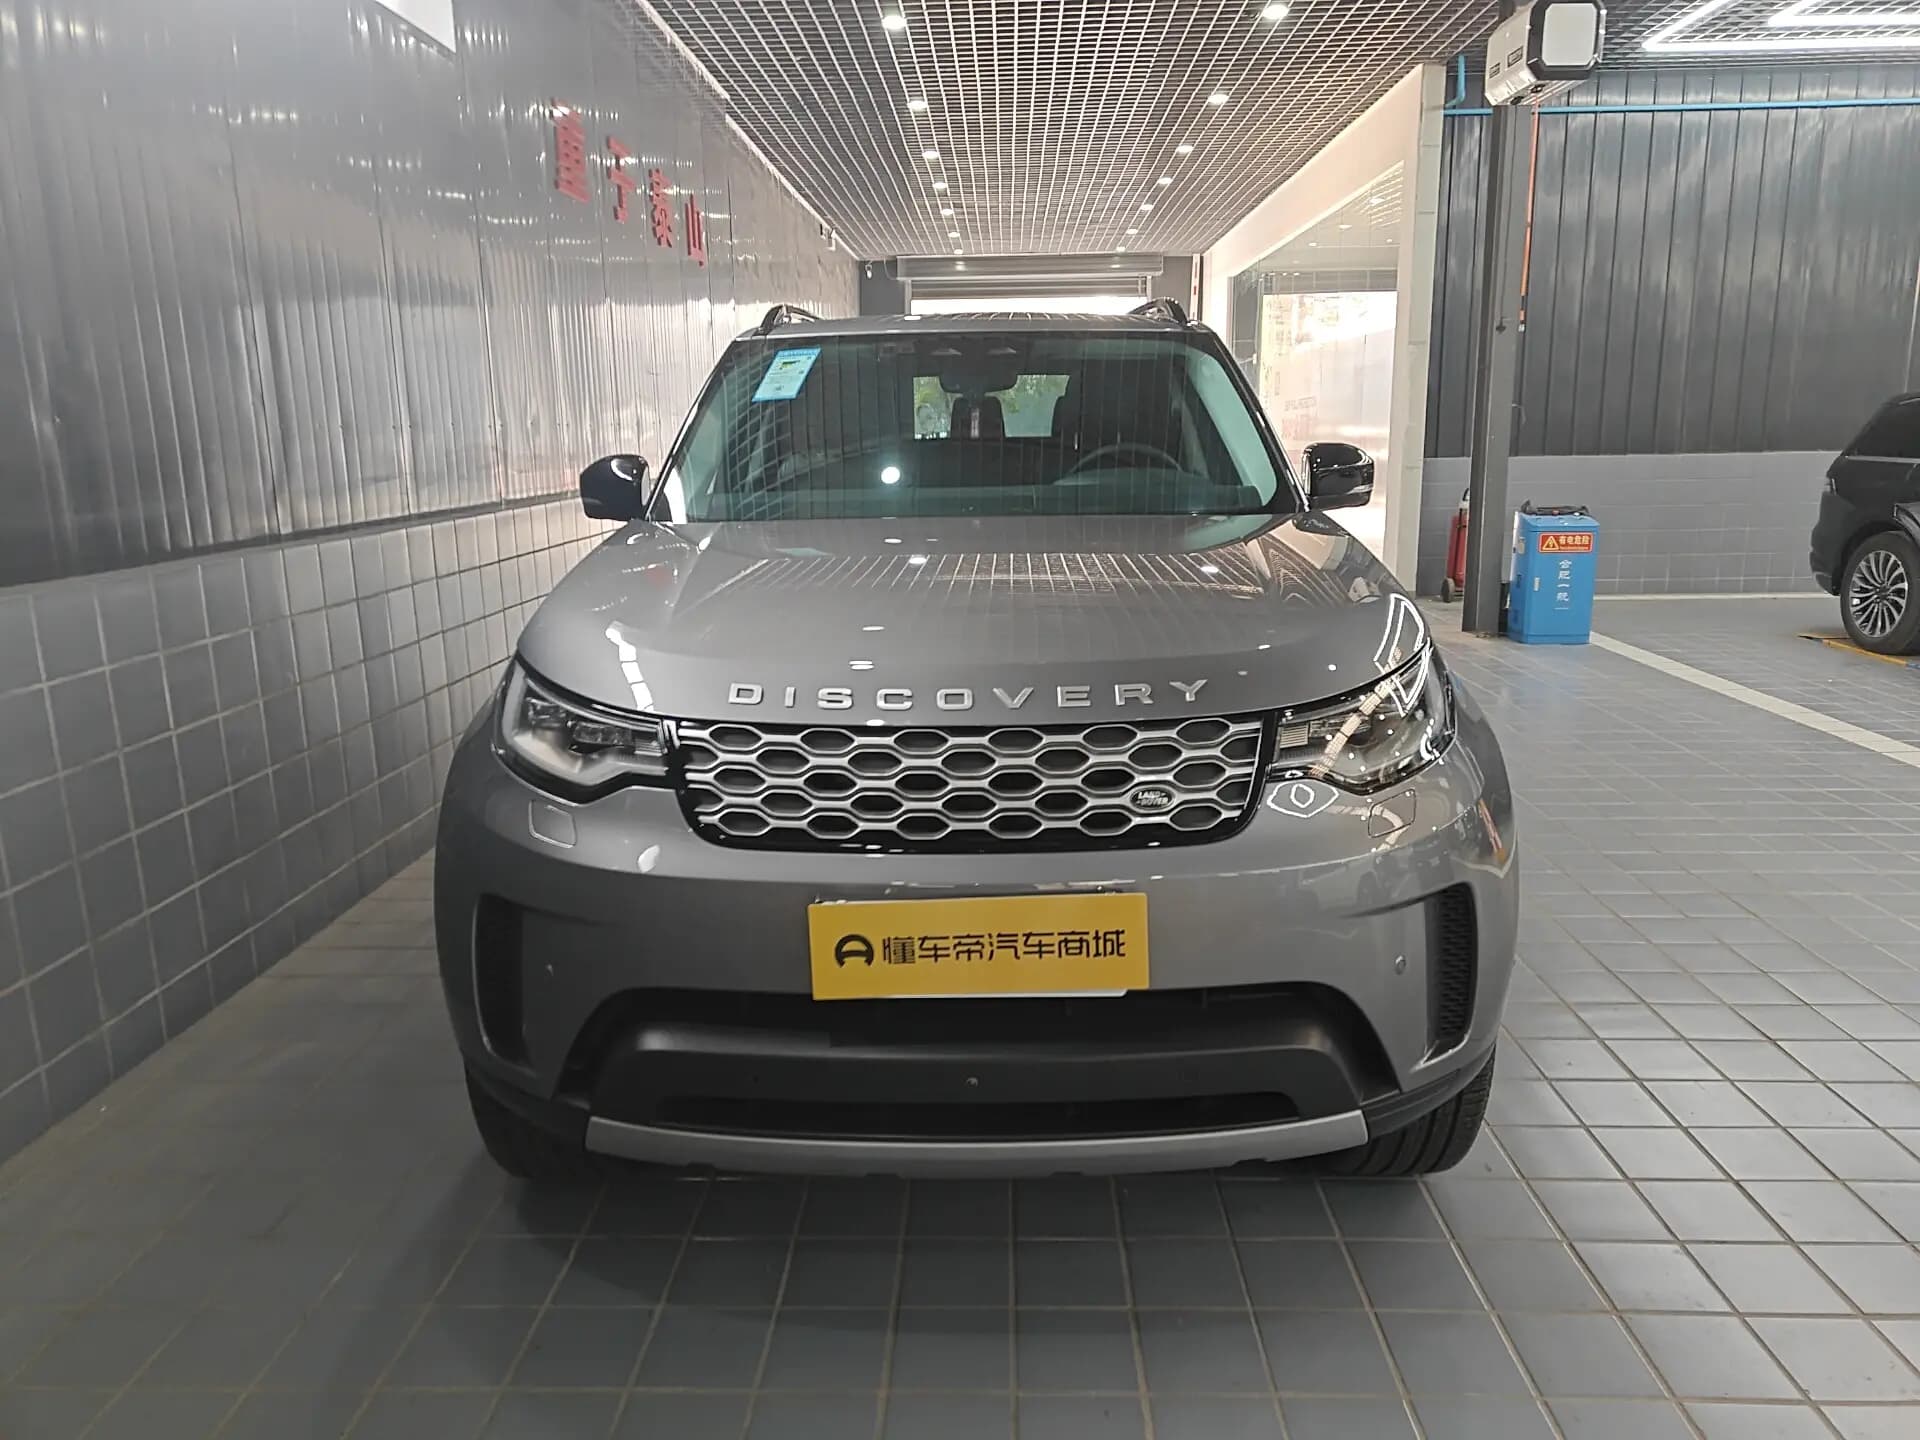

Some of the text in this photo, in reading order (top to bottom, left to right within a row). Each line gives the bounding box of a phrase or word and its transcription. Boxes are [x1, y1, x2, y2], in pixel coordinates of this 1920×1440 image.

[1559, 535, 1590, 545] 有电危险
[728, 678, 1208, 710] DISCOVERY
[1138, 790, 1161, 799] LAND
[882, 929, 1126, 965] 懂车帝汽车商城
